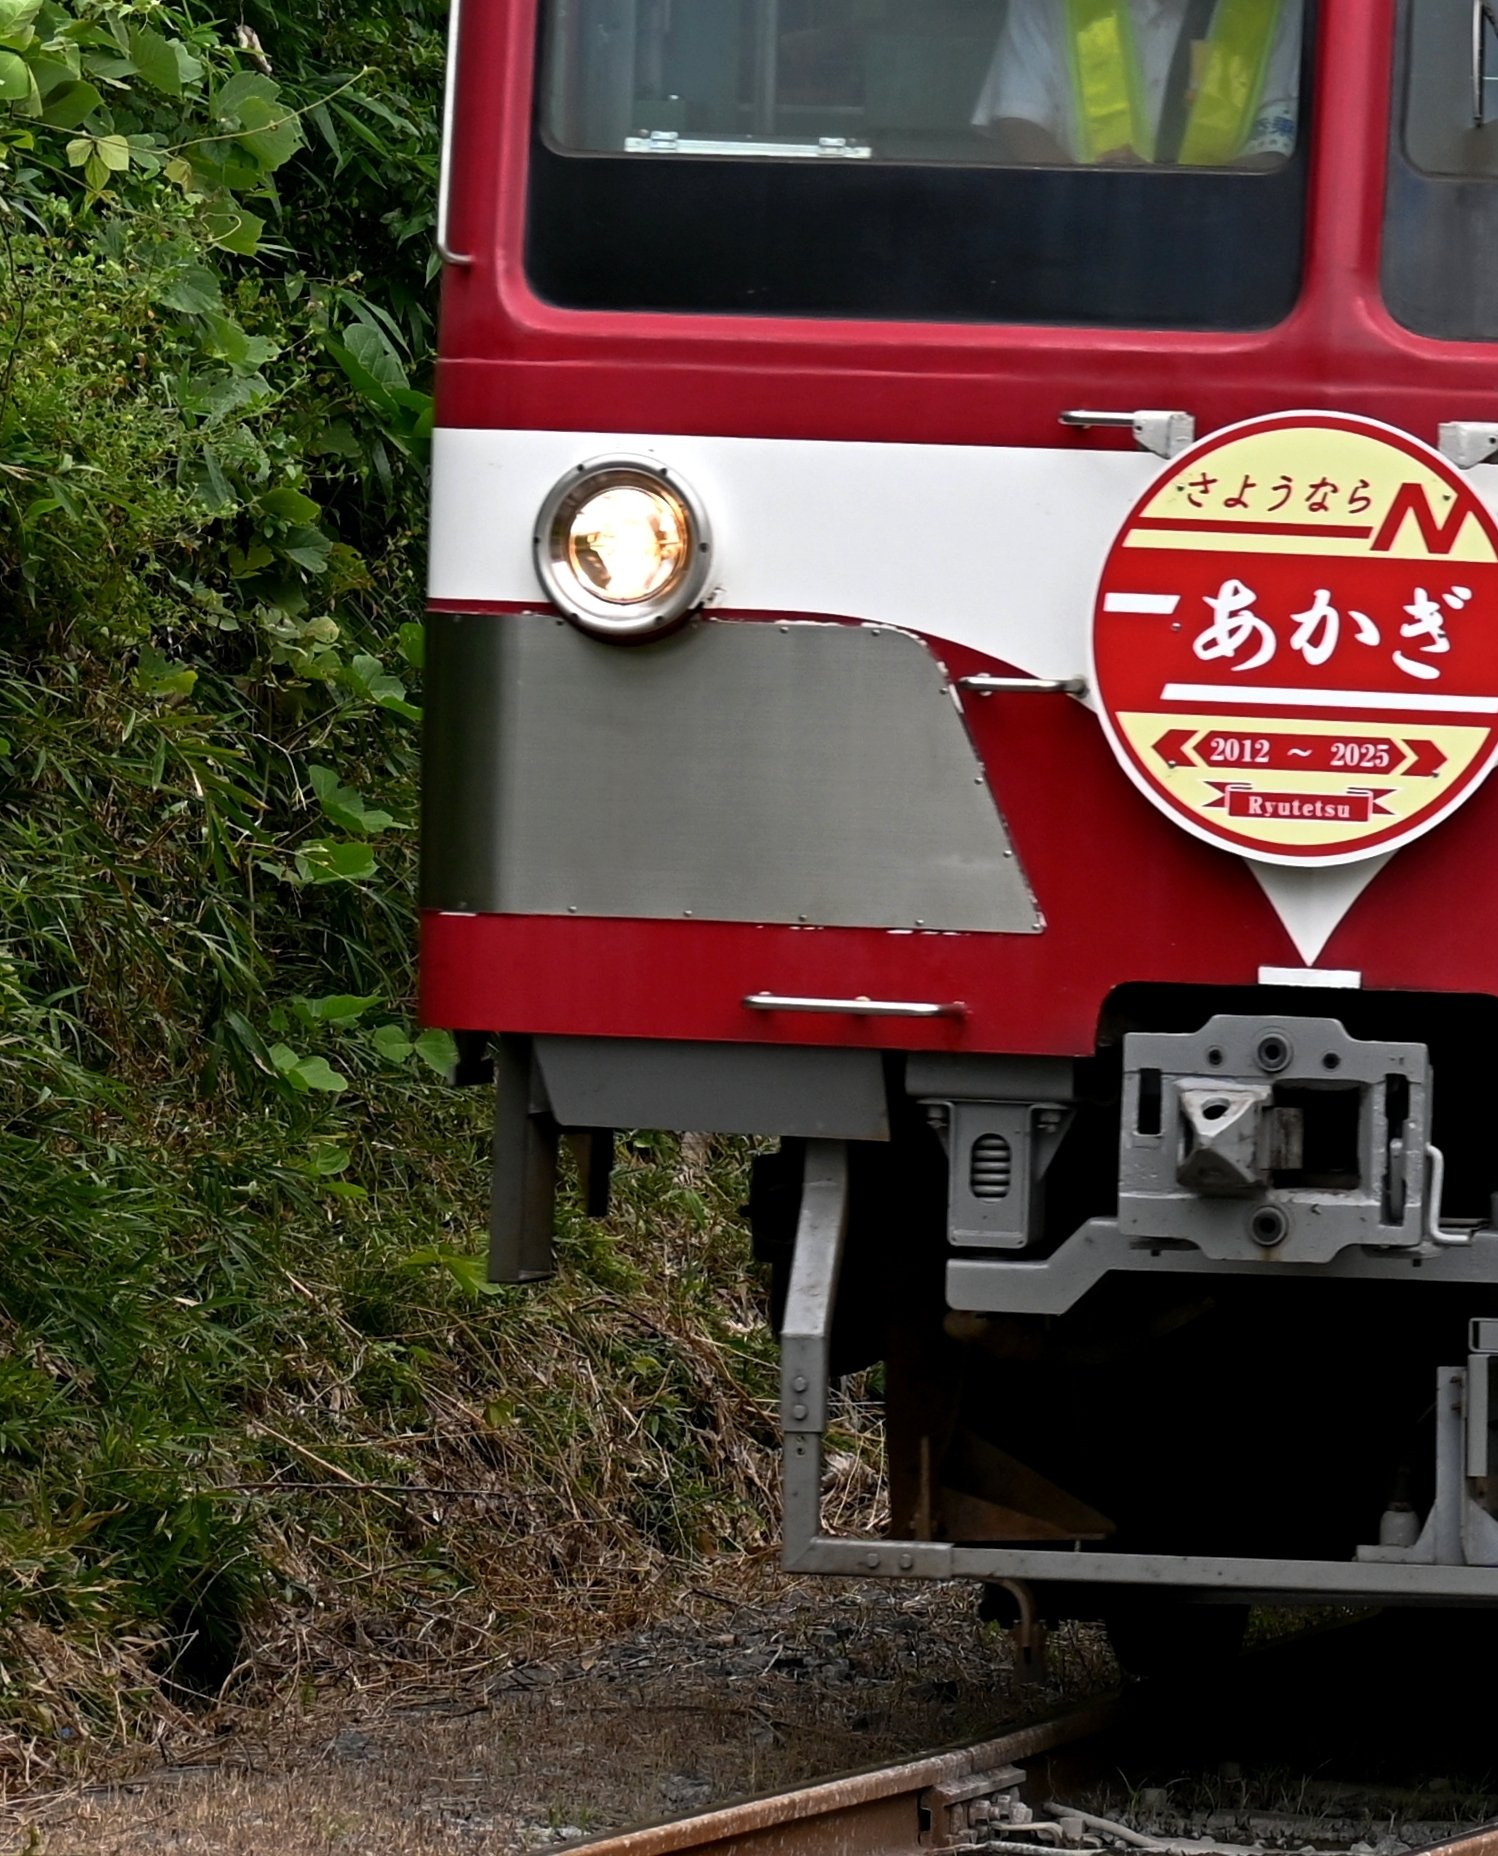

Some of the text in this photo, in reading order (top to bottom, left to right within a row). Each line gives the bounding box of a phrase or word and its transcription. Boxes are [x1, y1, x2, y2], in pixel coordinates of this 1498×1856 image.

[1186, 472, 1373, 514] さようなら
[1192, 578, 1473, 680] あかぎ
[1209, 736, 1271, 764] 2012
[1329, 741, 1391, 767] 2025
[1247, 795, 1352, 819] Ryutetsu
